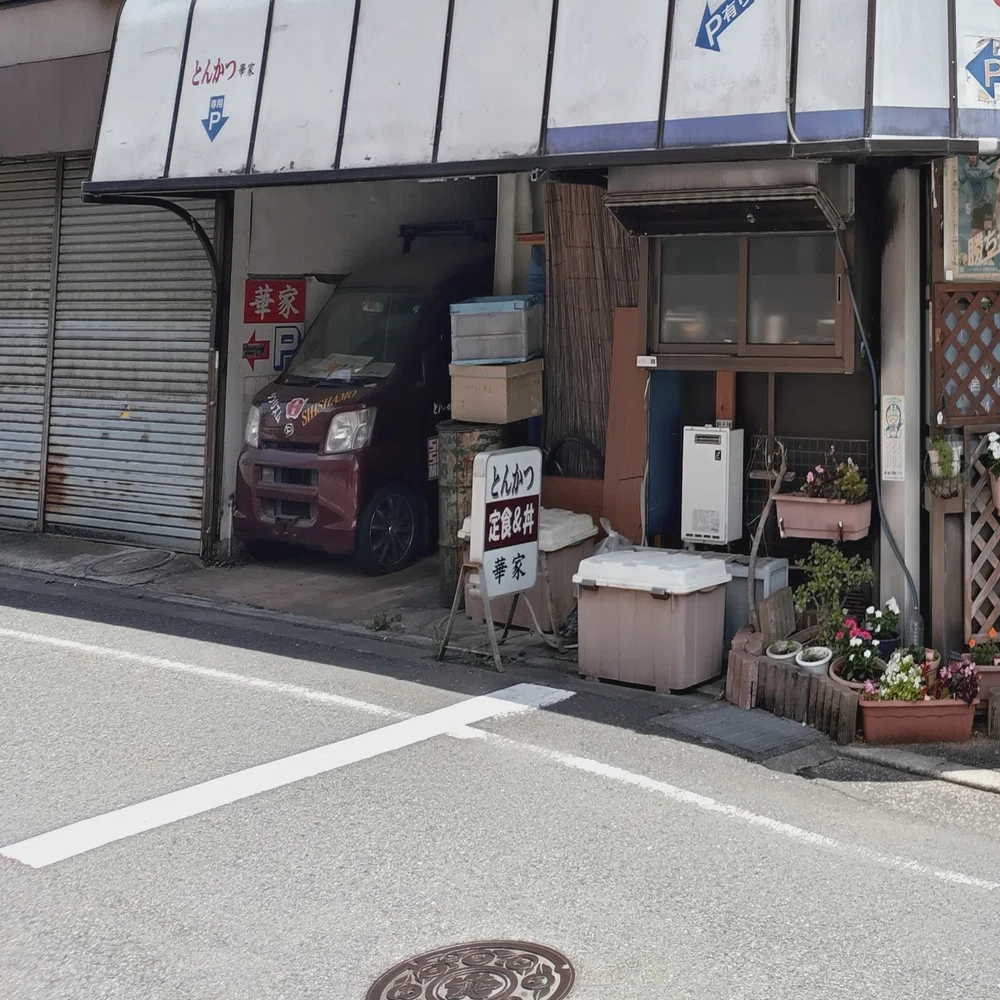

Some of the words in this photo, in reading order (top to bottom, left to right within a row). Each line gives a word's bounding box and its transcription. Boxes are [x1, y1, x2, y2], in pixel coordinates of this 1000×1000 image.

[192, 57, 236, 86] とんかつ
[238, 62, 255, 77] 華家
[208, 111, 222, 131] P
[249, 283, 299, 320] 華家
[273, 326, 302, 371] P
[301, 389, 357, 427] SHISHAMO
[491, 463, 534, 499] とんかつ
[488, 503, 534, 542] 定食&丼
[492, 553, 526, 584] 華家
